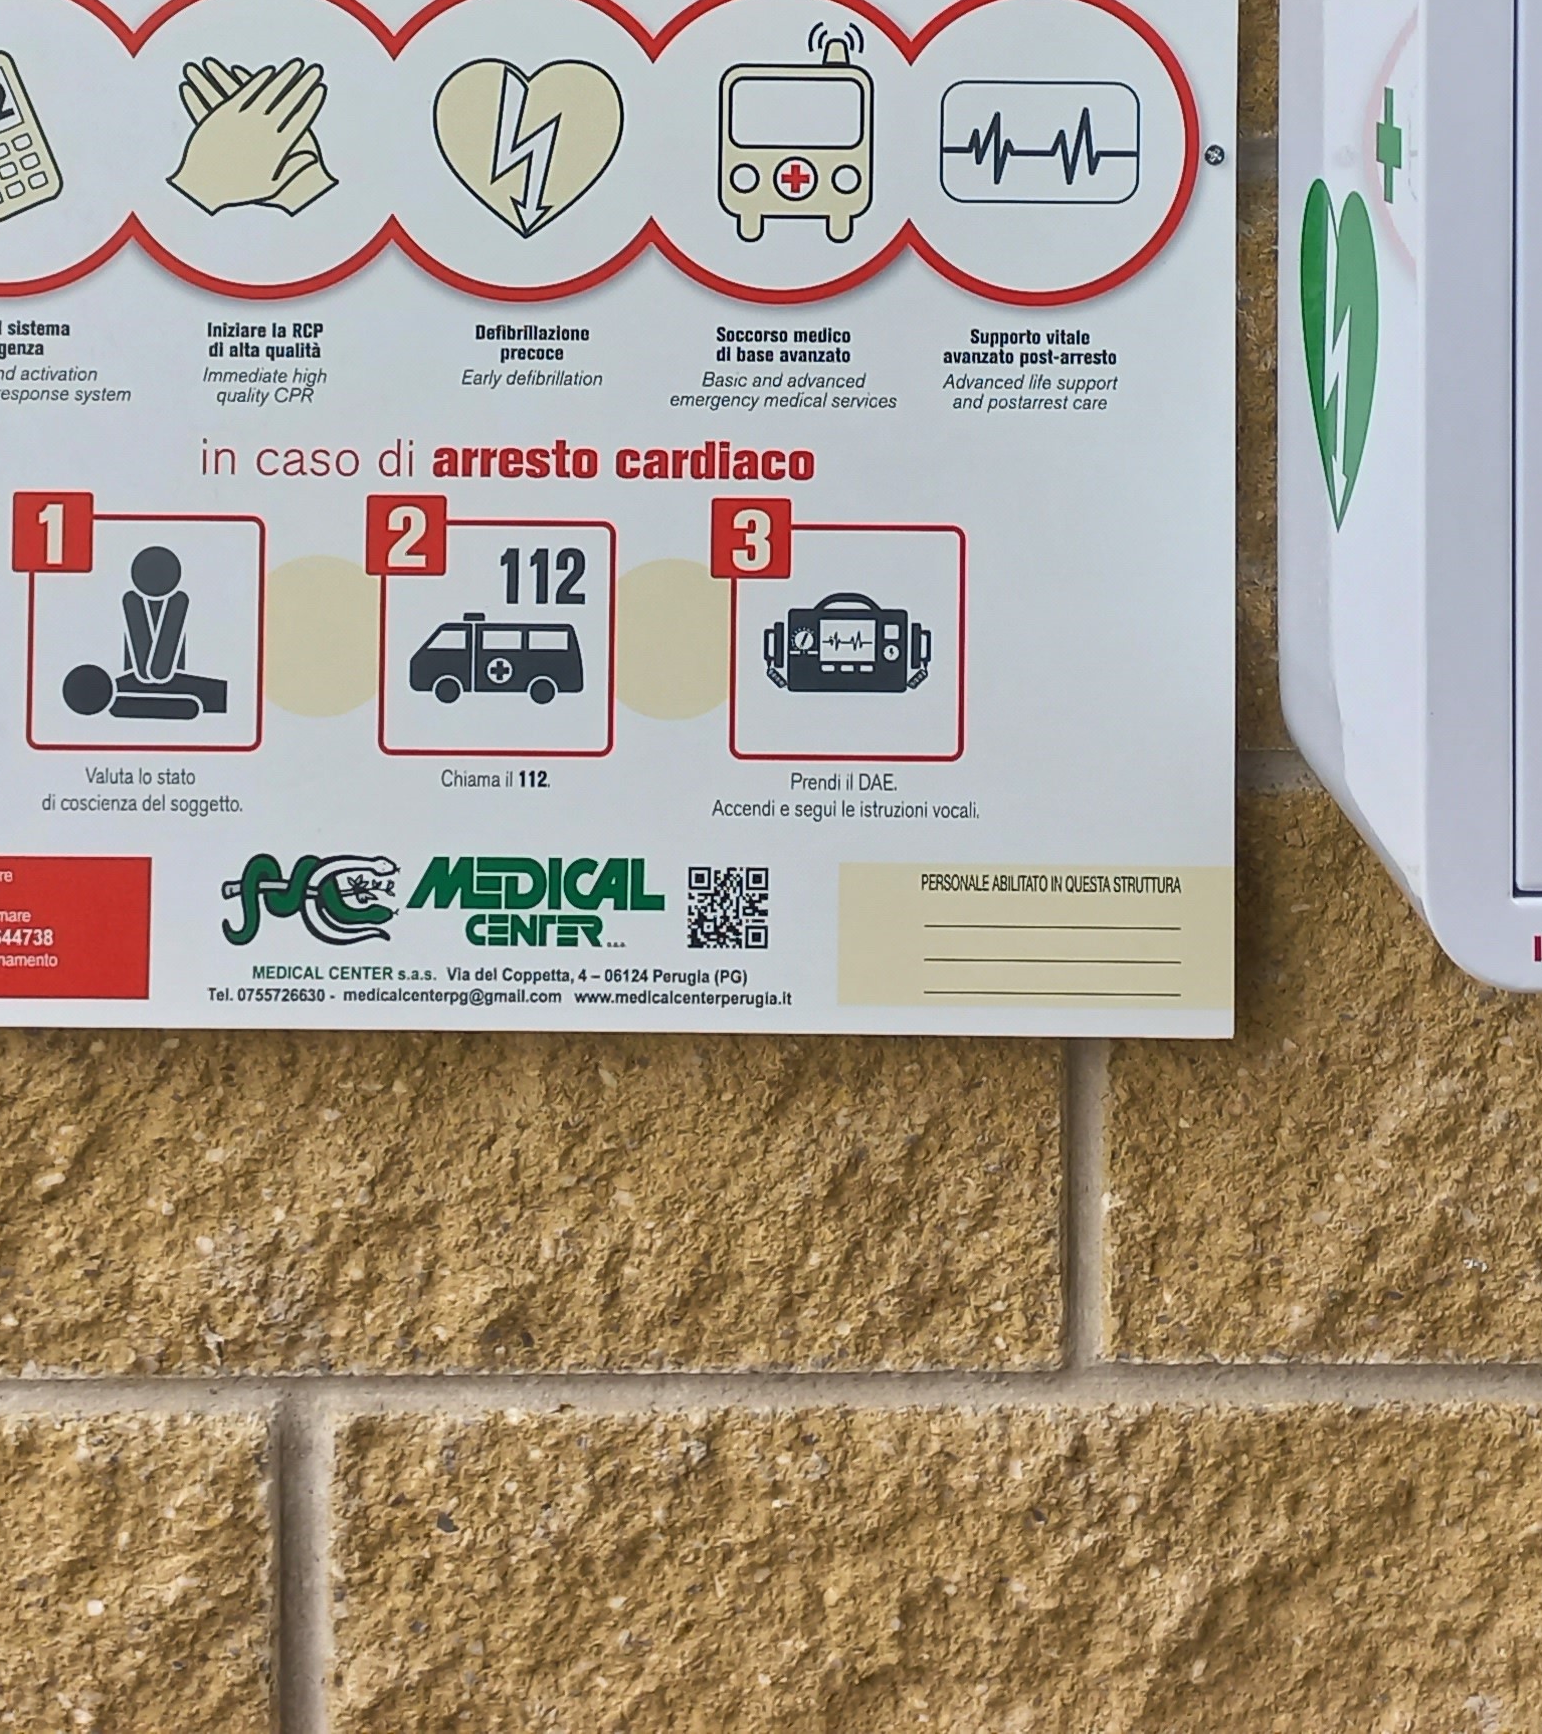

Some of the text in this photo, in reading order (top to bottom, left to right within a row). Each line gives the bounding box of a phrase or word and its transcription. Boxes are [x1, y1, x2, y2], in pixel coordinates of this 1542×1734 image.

[8, 321, 69, 336] sistema
[208, 323, 323, 338] Iniziare la RCP
[476, 325, 589, 340] Defibrillazione
[717, 327, 850, 343] Soccorso medico
[971, 329, 1089, 347] Supporto vitale
[209, 342, 320, 361] di alta qualità
[501, 348, 563, 363] precoce
[717, 347, 850, 362] di base avanzato
[944, 349, 1116, 367] avanzato post-arresto
[203, 367, 327, 387] Immediate high
[462, 370, 602, 389] Early defibrillation
[943, 374, 1118, 394] Advanced life support
[953, 394, 1107, 412] and postarrest care
[203, 438, 413, 476] in caso di
[433, 440, 814, 480] arresto cardiaco
[39, 504, 63, 564] 1
[388, 505, 426, 567] 2
[733, 508, 770, 571] 3
[501, 548, 585, 604] 112
[86, 767, 195, 785] Valuta lo stato
[442, 770, 550, 787] Chiama il 112.
[791, 773, 897, 791] Prendi il DAE.
[42, 794, 242, 817] di coscienza del soggetto.
[712, 800, 979, 822] Accendi e segui le istruzioni vocali.
[405, 856, 666, 911] MEDICAL
[922, 874, 1181, 893] PERSONALE ABILITATO IN QUESTA STRUTTURA
[466, 914, 603, 947] CENTER
[253, 966, 436, 980] MEDICAL CENTER s.a.s.
[448, 968, 748, 987] Via del Coppetta, 4 06124 Perugia (PG)
[209, 988, 325, 1002] Tel. 0755726630
[344, 988, 561, 1006] medicalcenterpg@gmail.com
[575, 990, 791, 1008] www.medicalcenterperugia.it
